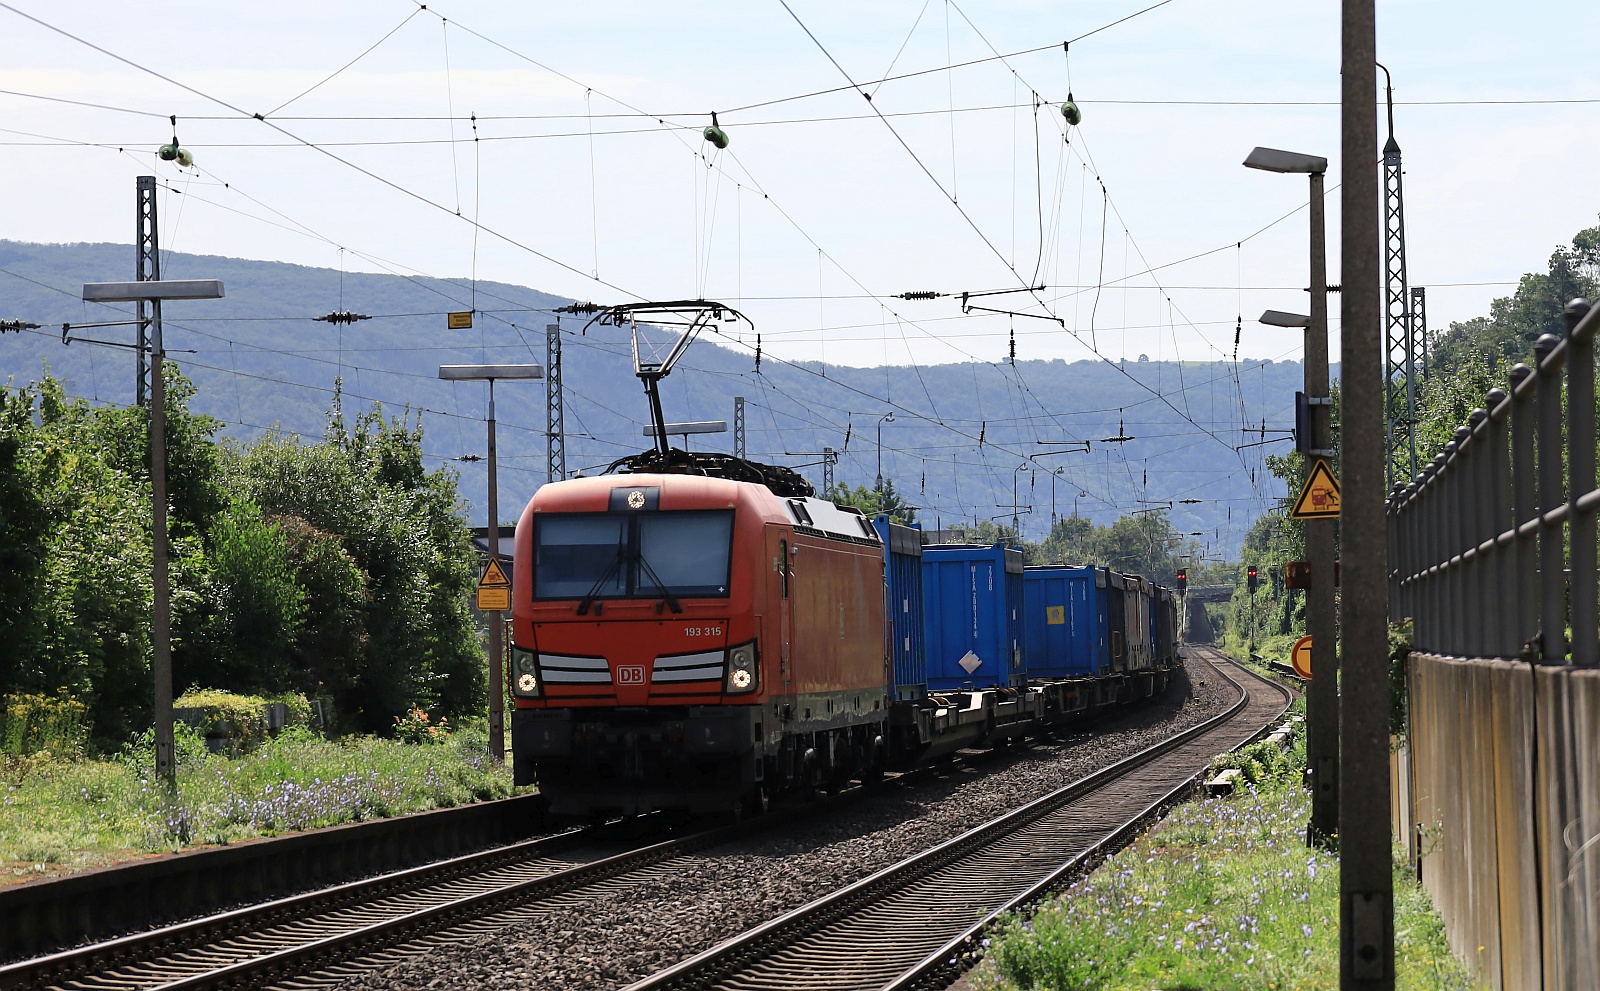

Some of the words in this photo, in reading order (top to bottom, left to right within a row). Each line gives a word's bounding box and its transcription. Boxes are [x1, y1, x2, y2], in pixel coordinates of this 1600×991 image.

[684, 627, 701, 636] 193
[704, 627, 722, 636] 315
[620, 668, 642, 682] DB
